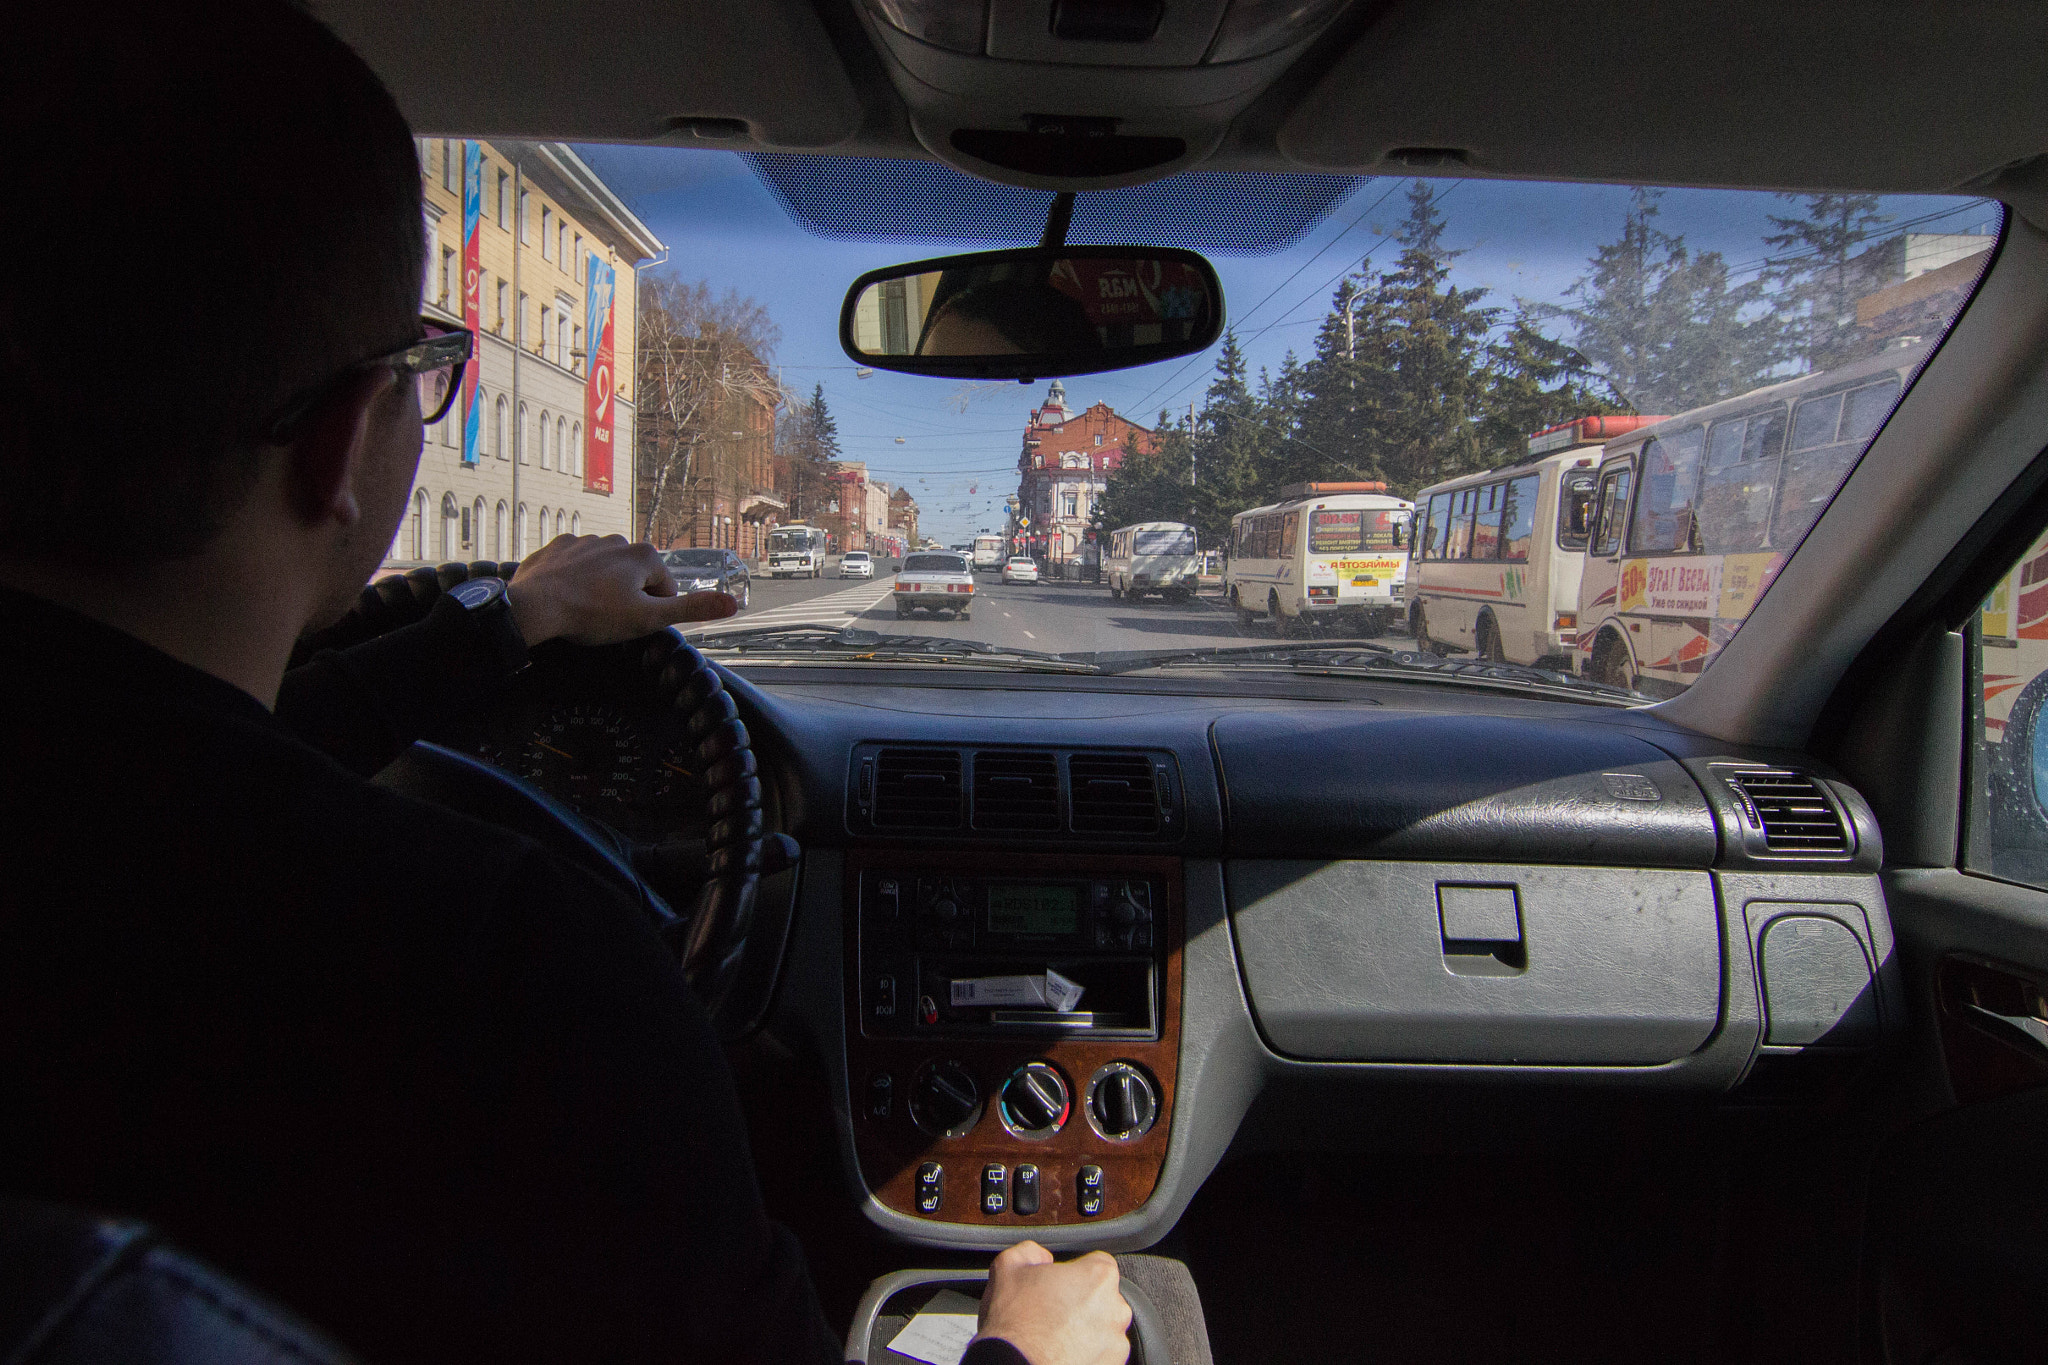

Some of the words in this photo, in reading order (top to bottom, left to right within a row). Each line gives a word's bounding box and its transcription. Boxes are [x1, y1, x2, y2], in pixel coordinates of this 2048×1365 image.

[594, 364, 610, 422] 9
[1330, 559, 1400, 569] АВТОЗАЙМЫ
[1621, 565, 1647, 602] 50%
[1648, 566, 1676, 593] УРА!
[1651, 597, 1664, 608] Уже
[1676, 596, 1708, 611] скидкой
[1022, 1171, 1034, 1179] ESP
